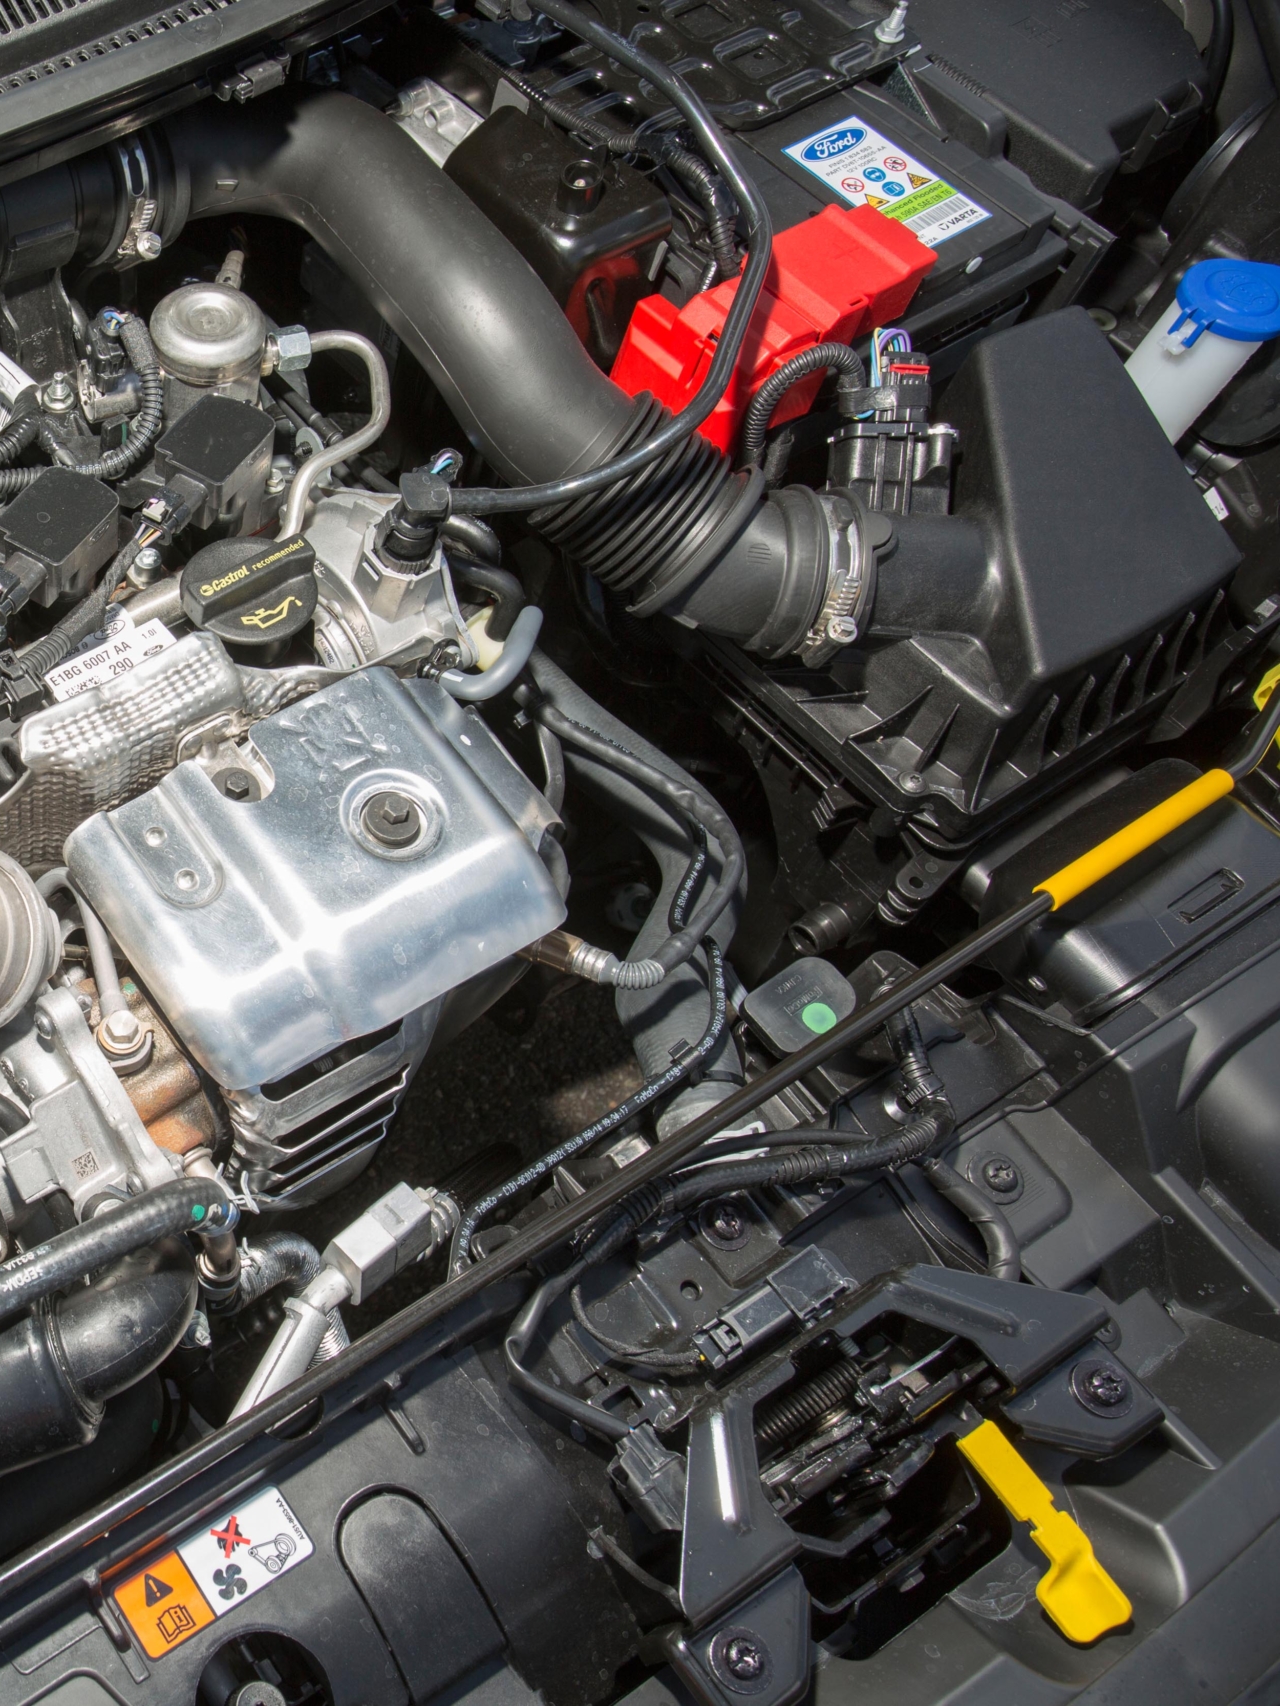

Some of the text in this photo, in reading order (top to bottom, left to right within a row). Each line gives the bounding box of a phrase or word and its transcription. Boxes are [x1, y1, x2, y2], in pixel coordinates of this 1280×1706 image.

[813, 132, 854, 157] Ford
[883, 182, 943, 216] nhanced Flooded
[917, 192, 943, 210] SAE/EN
[946, 206, 978, 227] VARTA
[210, 538, 305, 592] Castrol recommended
[48, 664, 82, 687] E1BG
[82, 649, 111, 670] 6007
[113, 640, 132, 655] AA
[107, 656, 134, 676] 290
